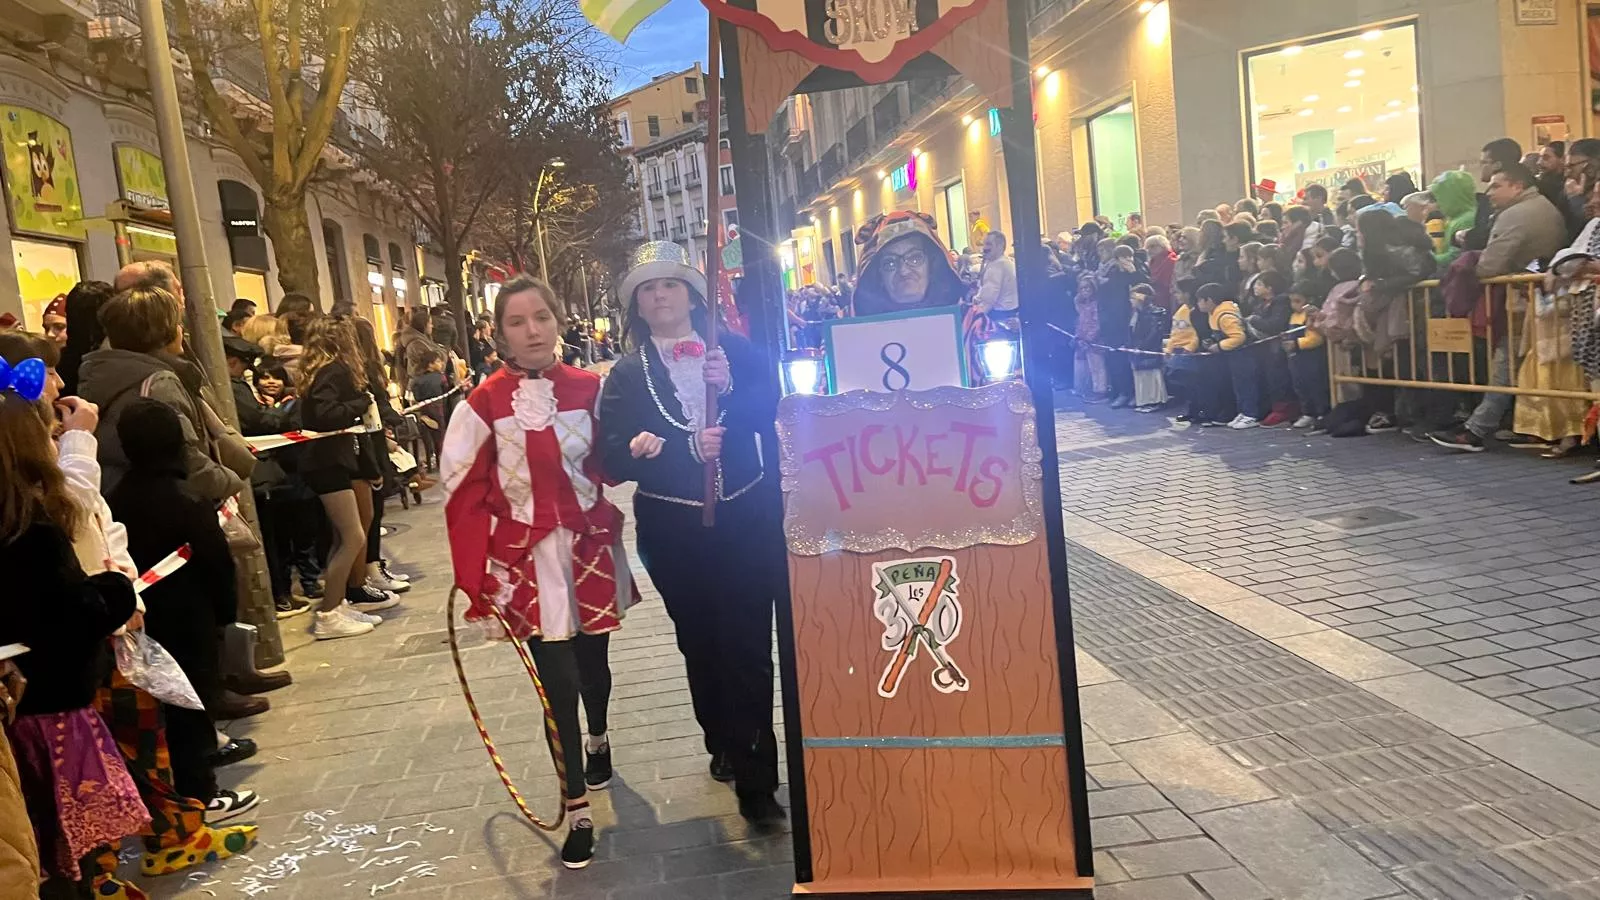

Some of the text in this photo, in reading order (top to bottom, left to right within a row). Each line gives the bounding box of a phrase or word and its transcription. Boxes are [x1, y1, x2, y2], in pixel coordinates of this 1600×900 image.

[880, 342, 910, 391] 8
[803, 421, 1009, 512] TICKETS
[891, 564, 936, 581] PEÑA
